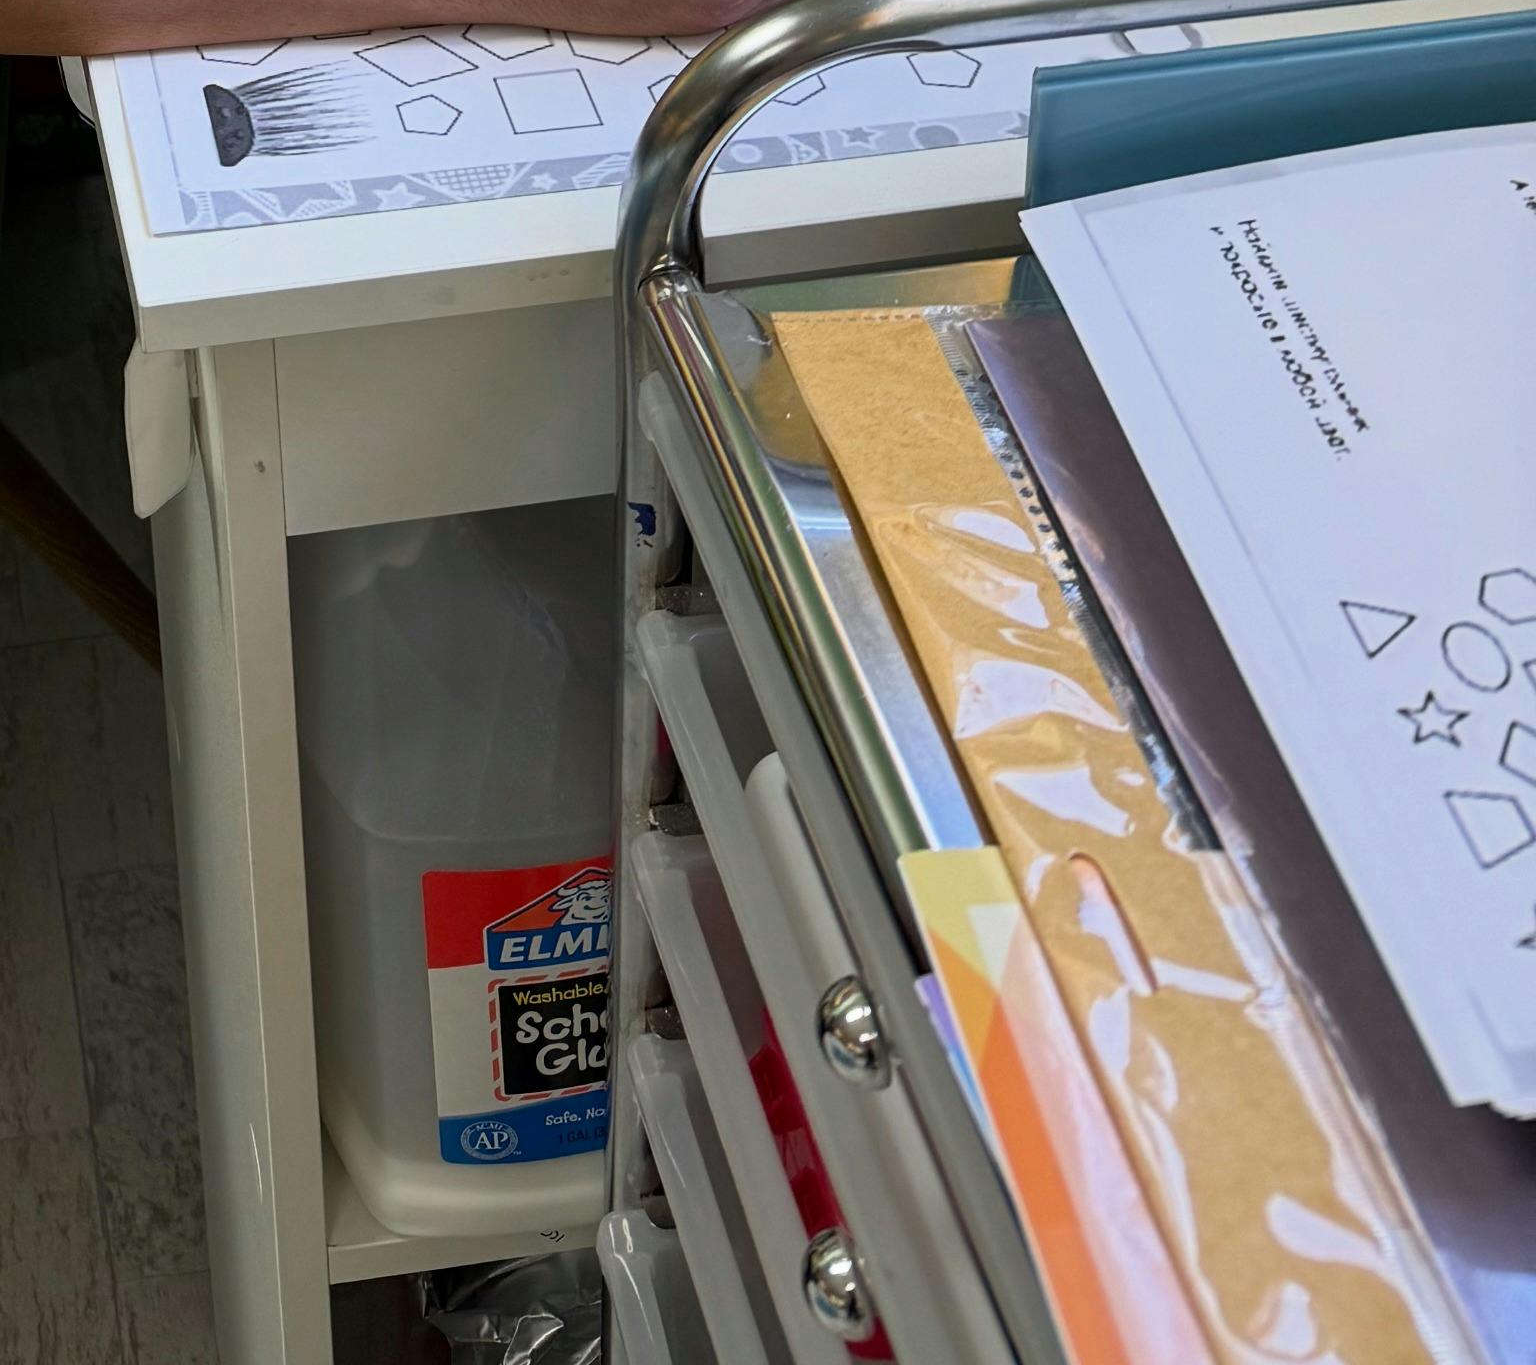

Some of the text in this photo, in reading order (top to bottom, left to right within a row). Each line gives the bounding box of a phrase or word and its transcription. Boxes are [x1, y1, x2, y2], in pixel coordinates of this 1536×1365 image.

[499, 925, 609, 963] ELM
[535, 1038, 608, 1077] Glu
[545, 1110, 581, 1127] Safe.
[473, 1132, 510, 1152] AP
